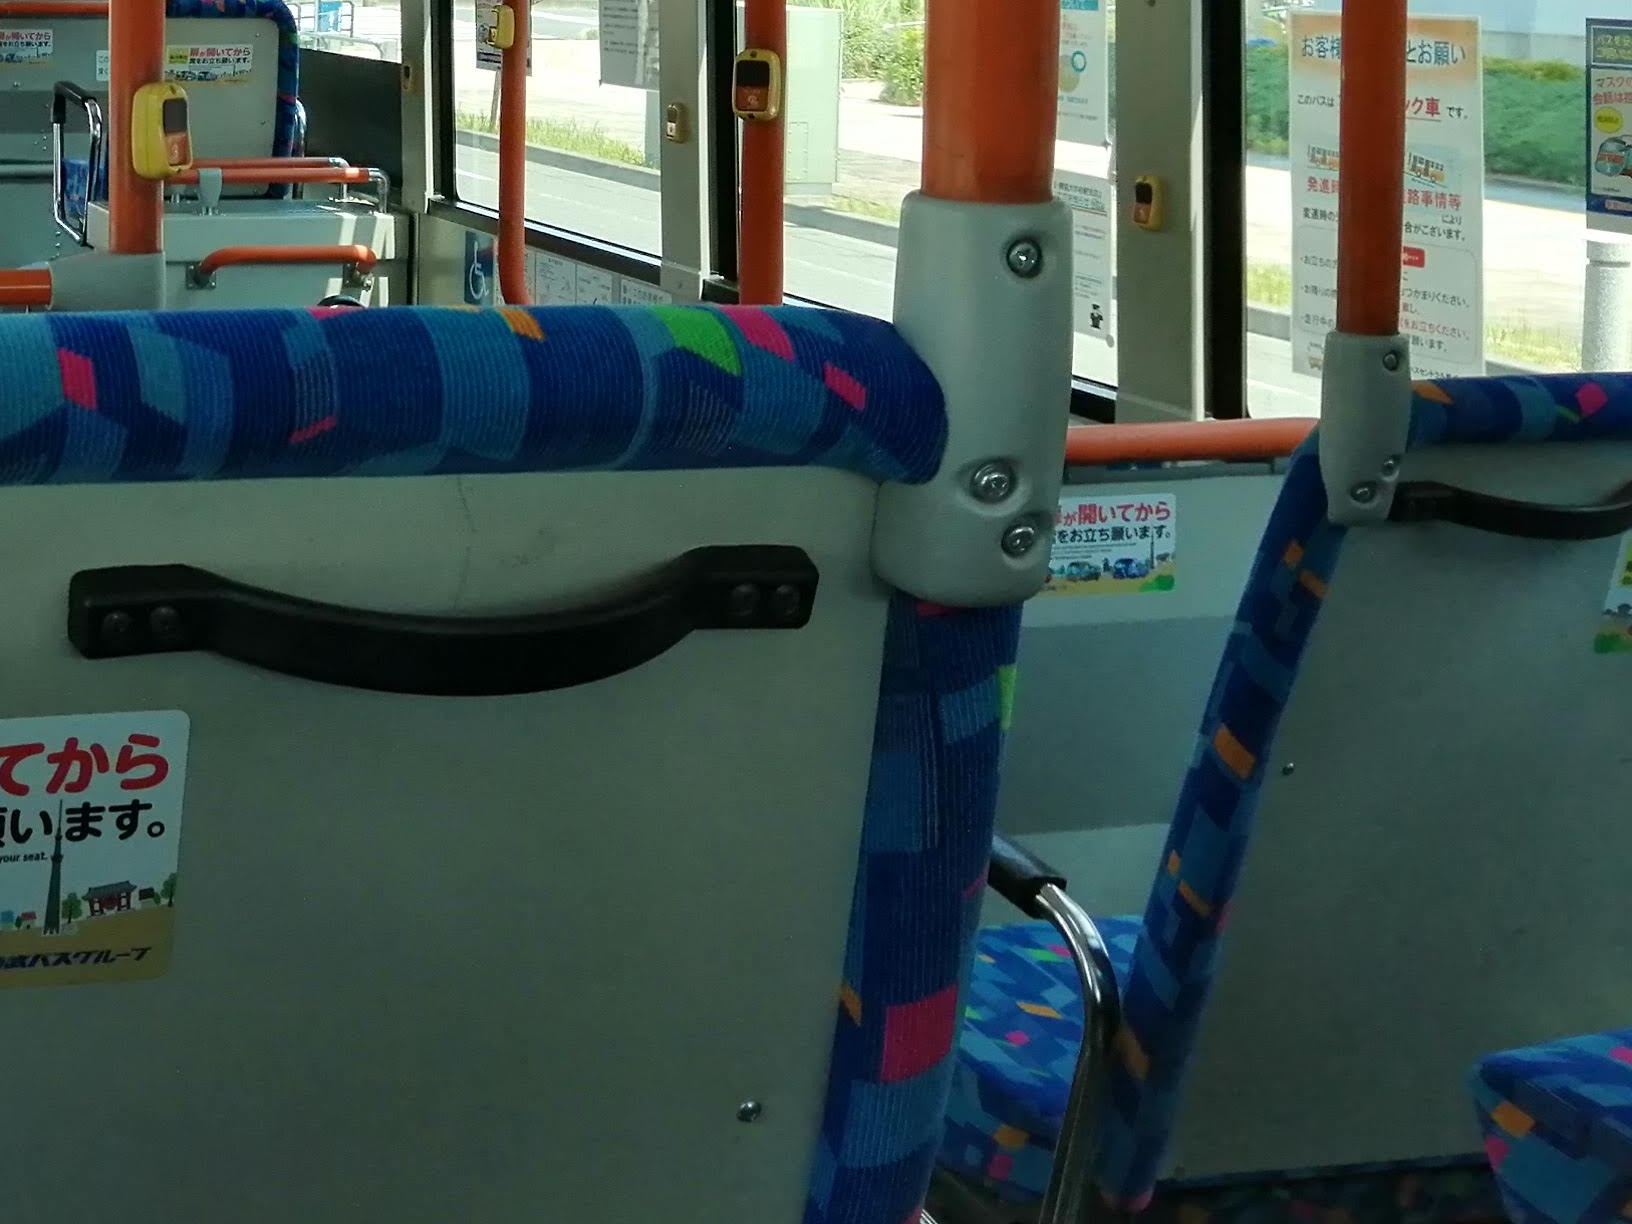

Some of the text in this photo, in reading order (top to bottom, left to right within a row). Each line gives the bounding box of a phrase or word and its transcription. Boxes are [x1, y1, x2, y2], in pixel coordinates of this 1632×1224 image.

[1056, 524, 1171, 543] をお立ち願います。
[22, 851, 48, 862] seat.
